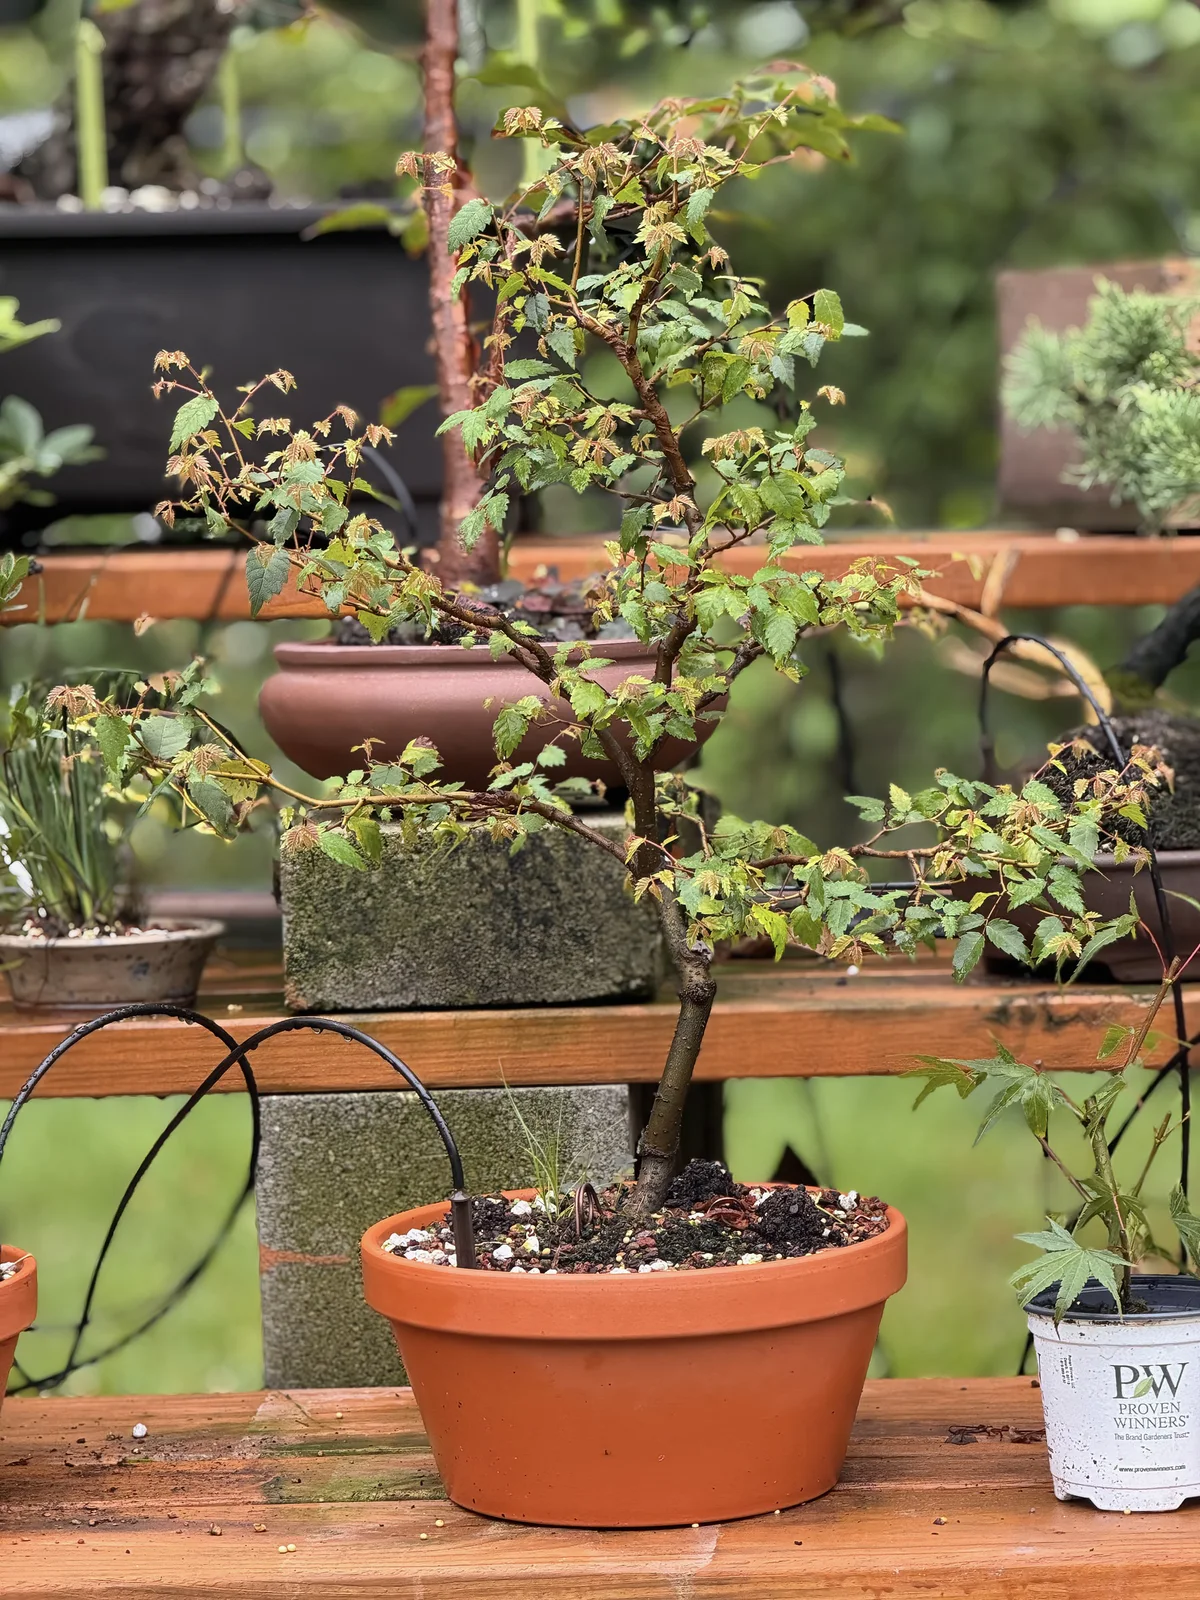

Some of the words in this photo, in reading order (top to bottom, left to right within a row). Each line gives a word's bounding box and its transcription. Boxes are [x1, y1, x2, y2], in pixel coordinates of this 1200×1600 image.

[1110, 1362, 1189, 1399] PW
[1119, 1402, 1181, 1415] PROVEN
[1113, 1415, 1189, 1430] WINNERS
[1118, 1464, 1186, 1473] www.provenwinners.com
